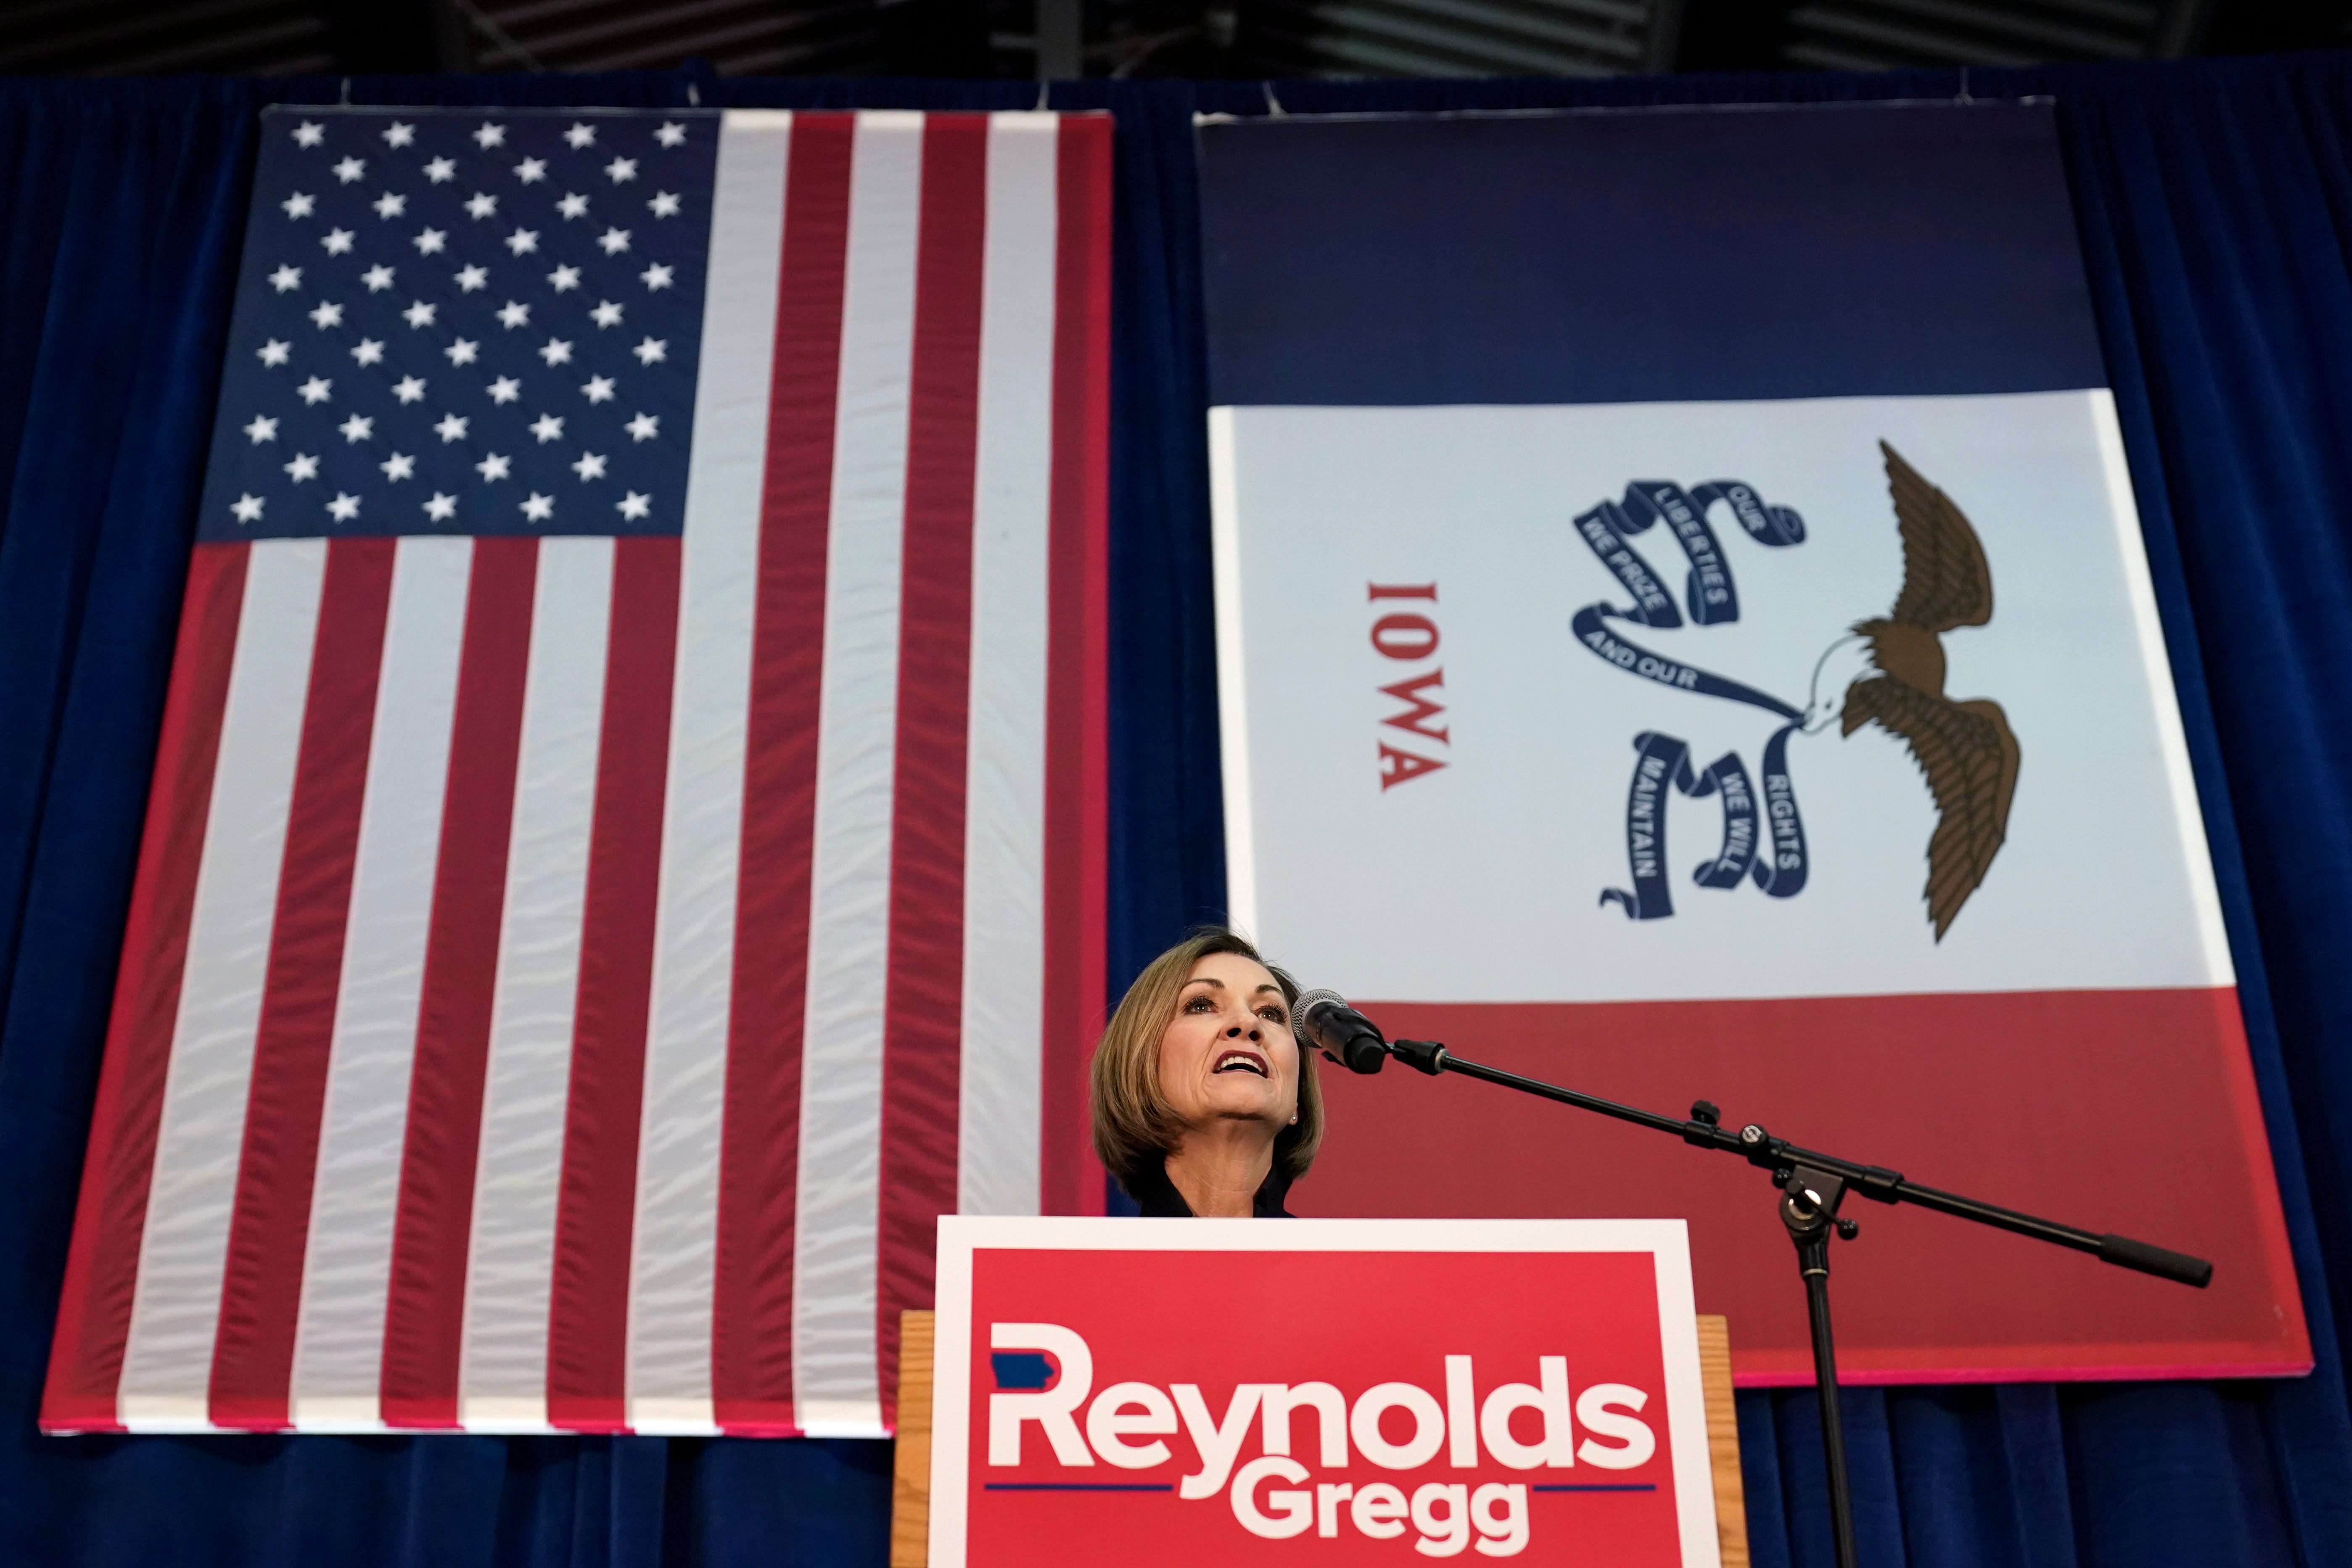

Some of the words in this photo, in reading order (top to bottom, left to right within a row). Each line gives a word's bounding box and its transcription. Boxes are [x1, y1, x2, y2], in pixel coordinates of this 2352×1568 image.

[1654, 487, 1728, 604] LIBERTIES
[1728, 486, 1766, 531] OUR
[1583, 517, 1619, 555] WE
[1608, 550, 1668, 611] PRIZE
[1367, 580, 1450, 792] IOWA
[1585, 631, 1636, 668] AND
[1638, 657, 1698, 689] OUR
[1632, 756, 1666, 877] MAINTAIN
[1722, 773, 1749, 811] WE
[1767, 775, 1801, 870] RIGHTS
[1718, 818, 1752, 872] WILL
[988, 1322, 1656, 1499] Reynolds
[1230, 1456, 1529, 1557] Gregg
